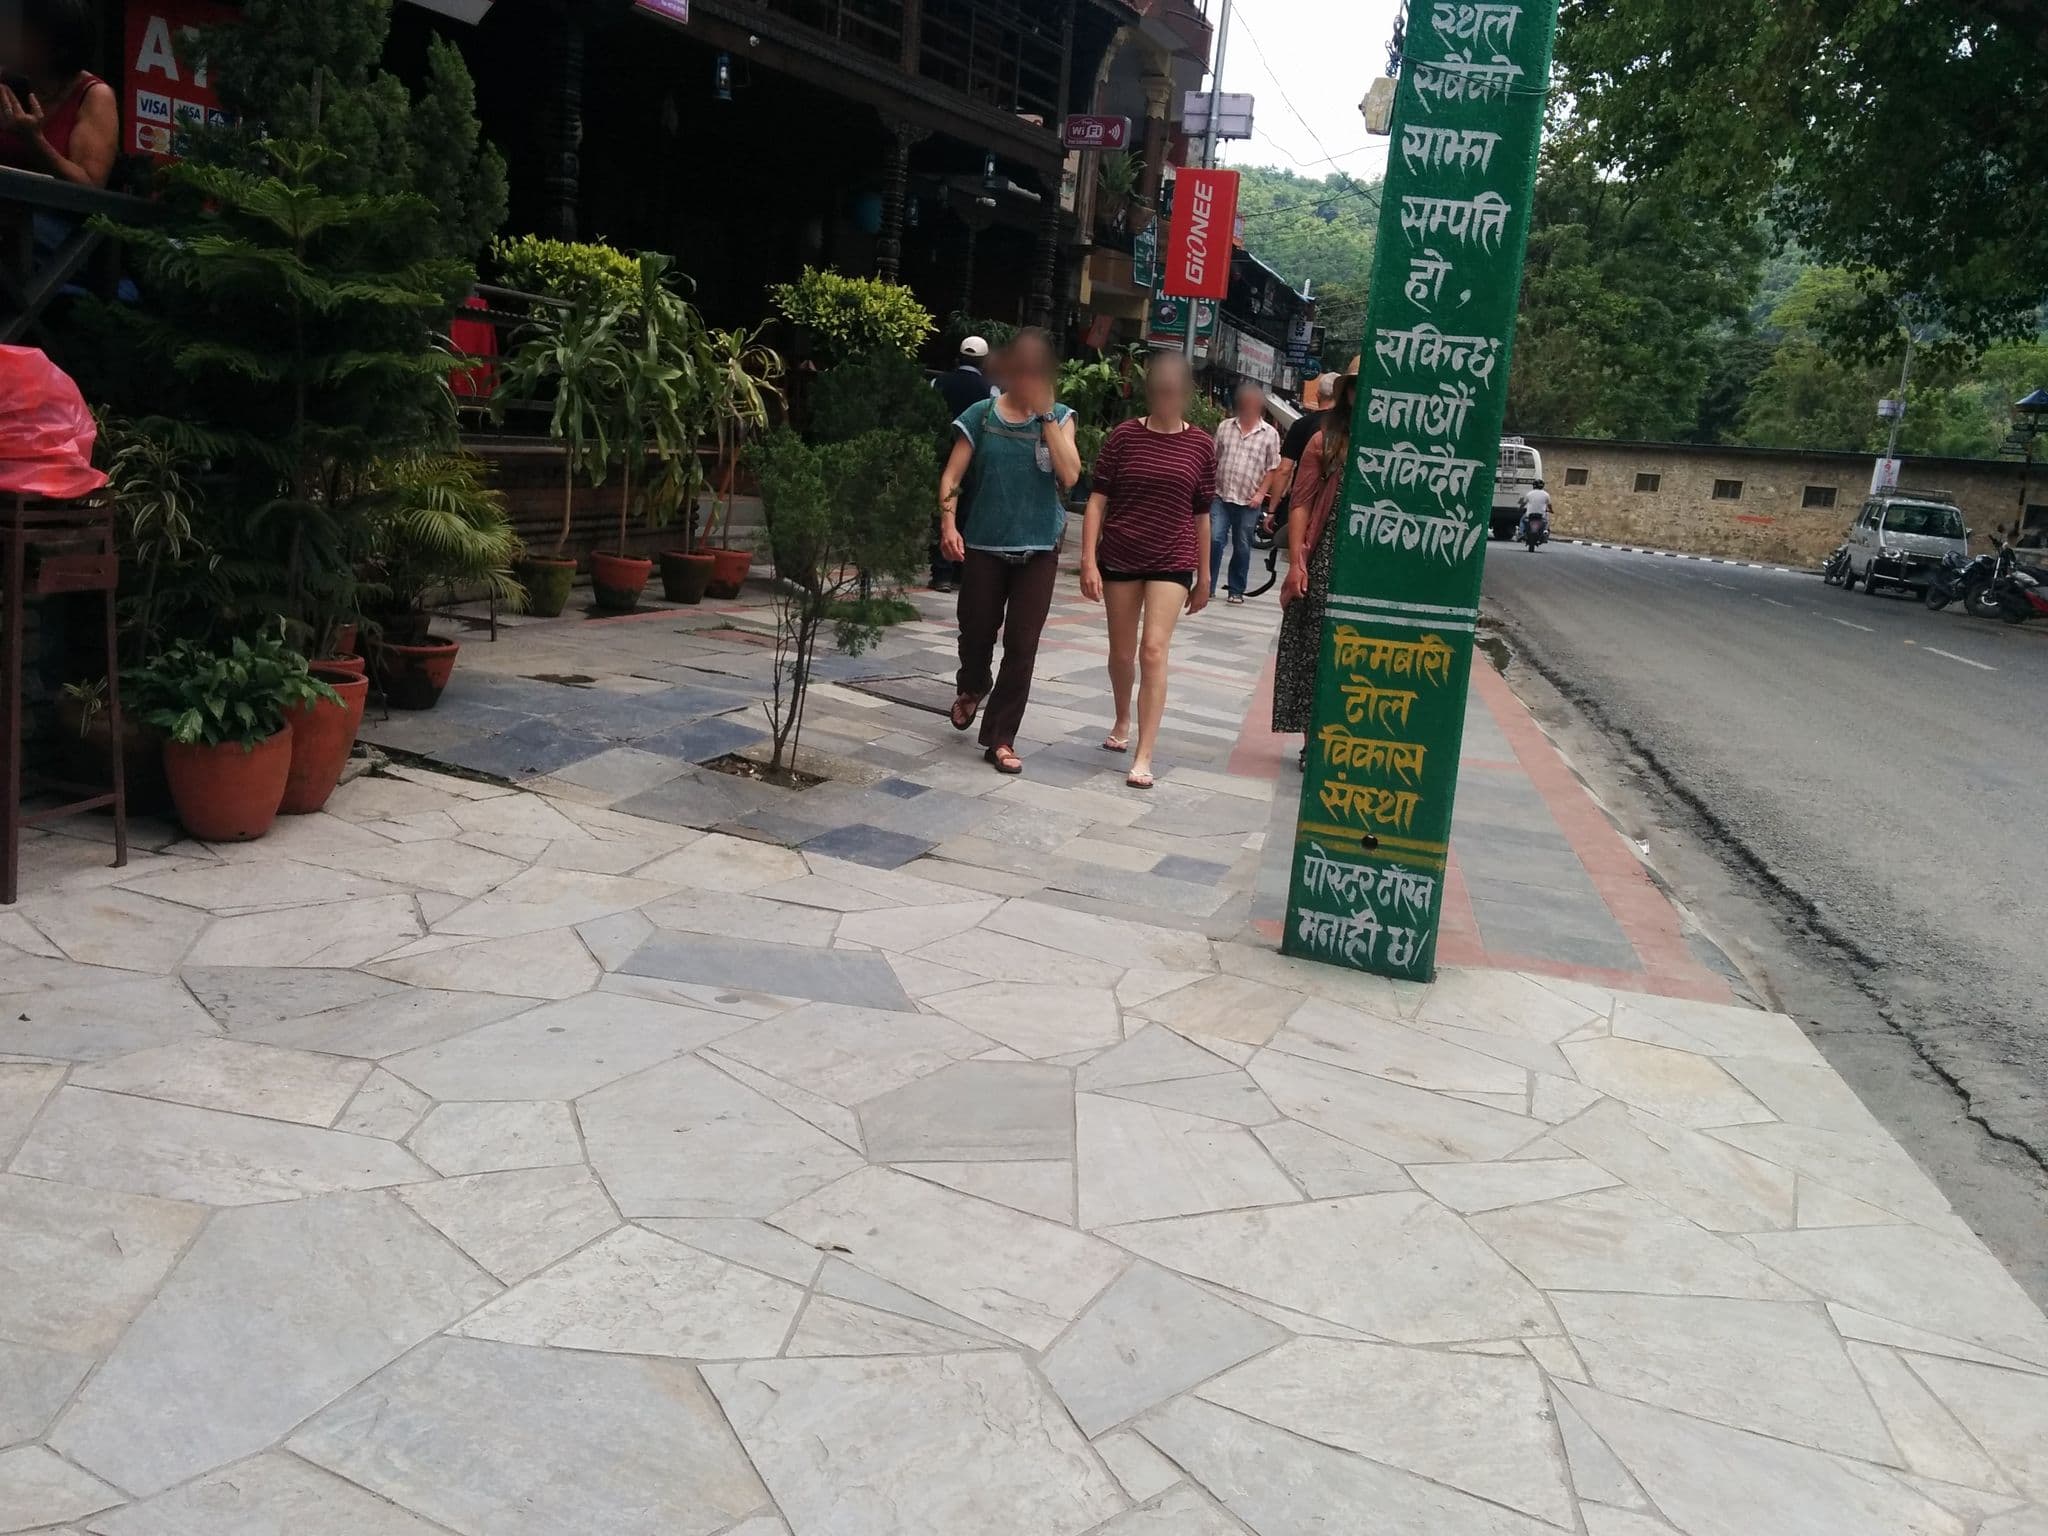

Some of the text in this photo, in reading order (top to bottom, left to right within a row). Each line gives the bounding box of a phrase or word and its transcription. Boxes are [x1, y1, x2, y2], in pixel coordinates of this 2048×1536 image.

[1431, 2, 1523, 55] स्थल
[140, 98, 169, 117] VISA
[1341, 673, 1418, 735] टोल
[1318, 724, 1428, 786] विकास
[1319, 771, 1421, 833] संस्था
